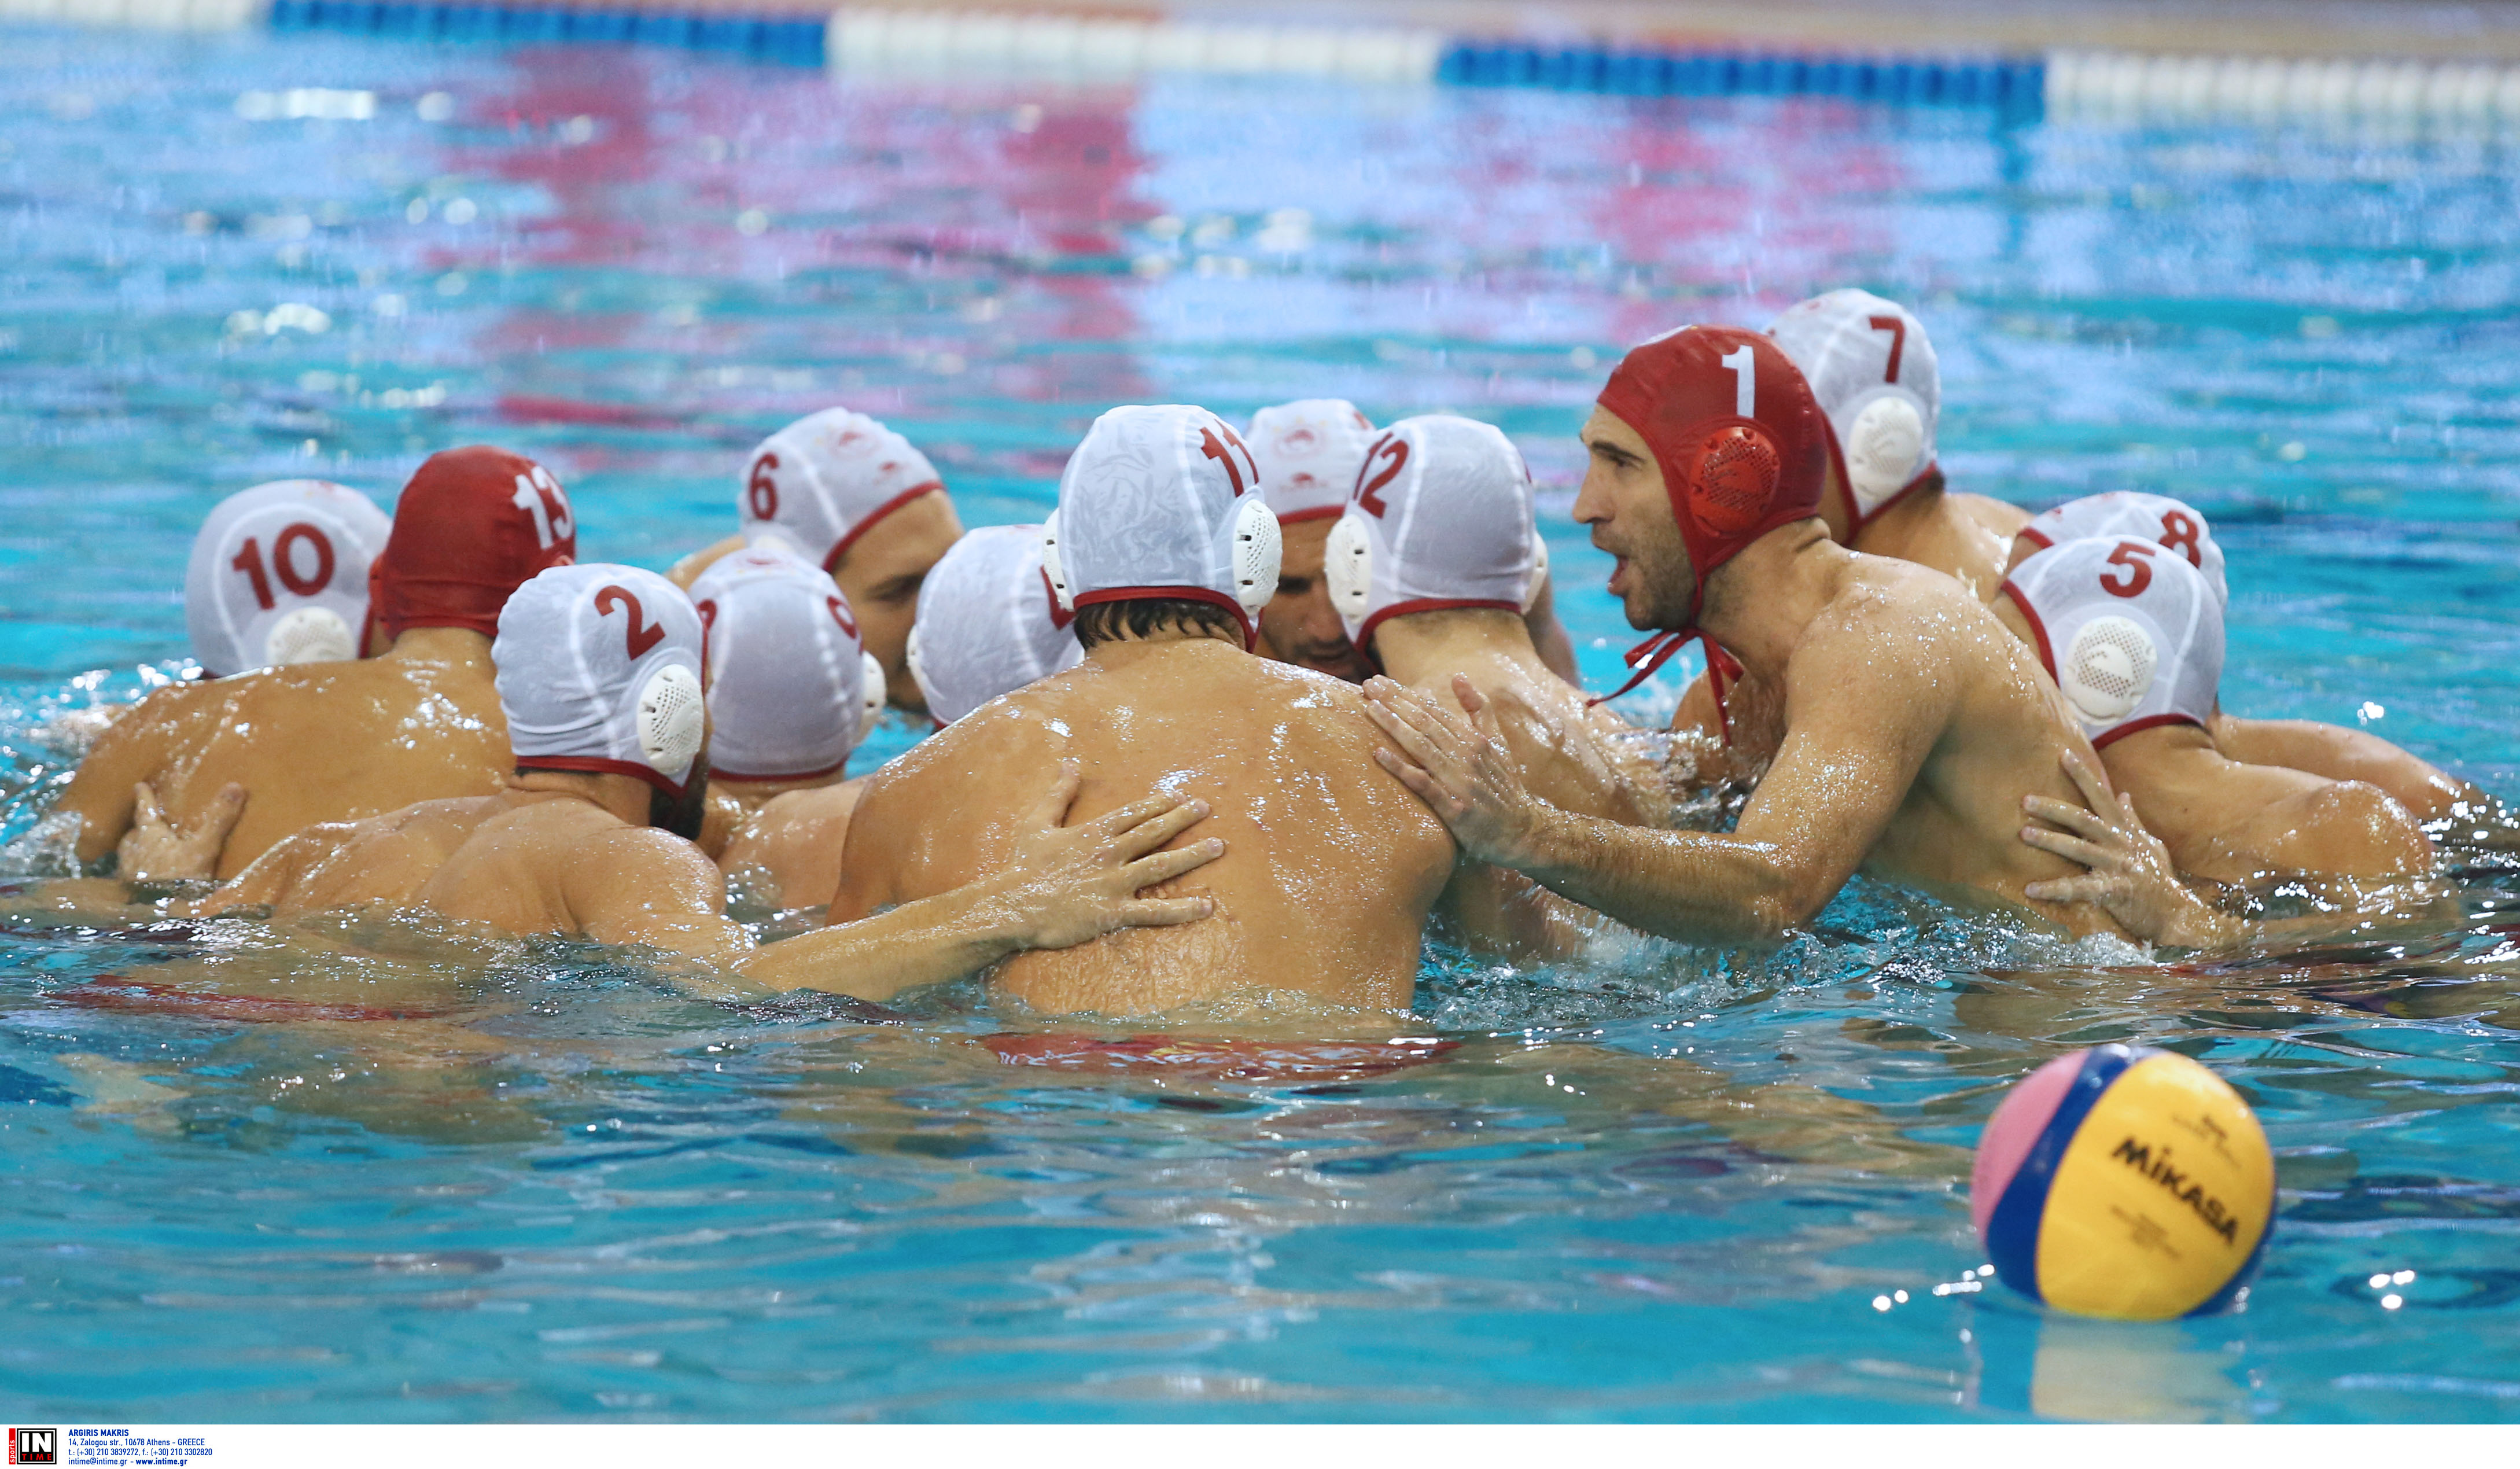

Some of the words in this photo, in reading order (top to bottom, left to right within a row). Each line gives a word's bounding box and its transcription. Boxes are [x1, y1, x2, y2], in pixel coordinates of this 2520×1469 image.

[1722, 345, 1755, 418] 1
[1869, 316, 1904, 383] 7
[749, 452, 780, 520] 6
[1200, 418, 1259, 498] 11
[1353, 432, 1409, 514] 12
[512, 466, 573, 550] 13
[2159, 510, 2201, 569] 8
[232, 522, 334, 610] 10
[2099, 542, 2156, 598] 5
[595, 584, 665, 661] 2
